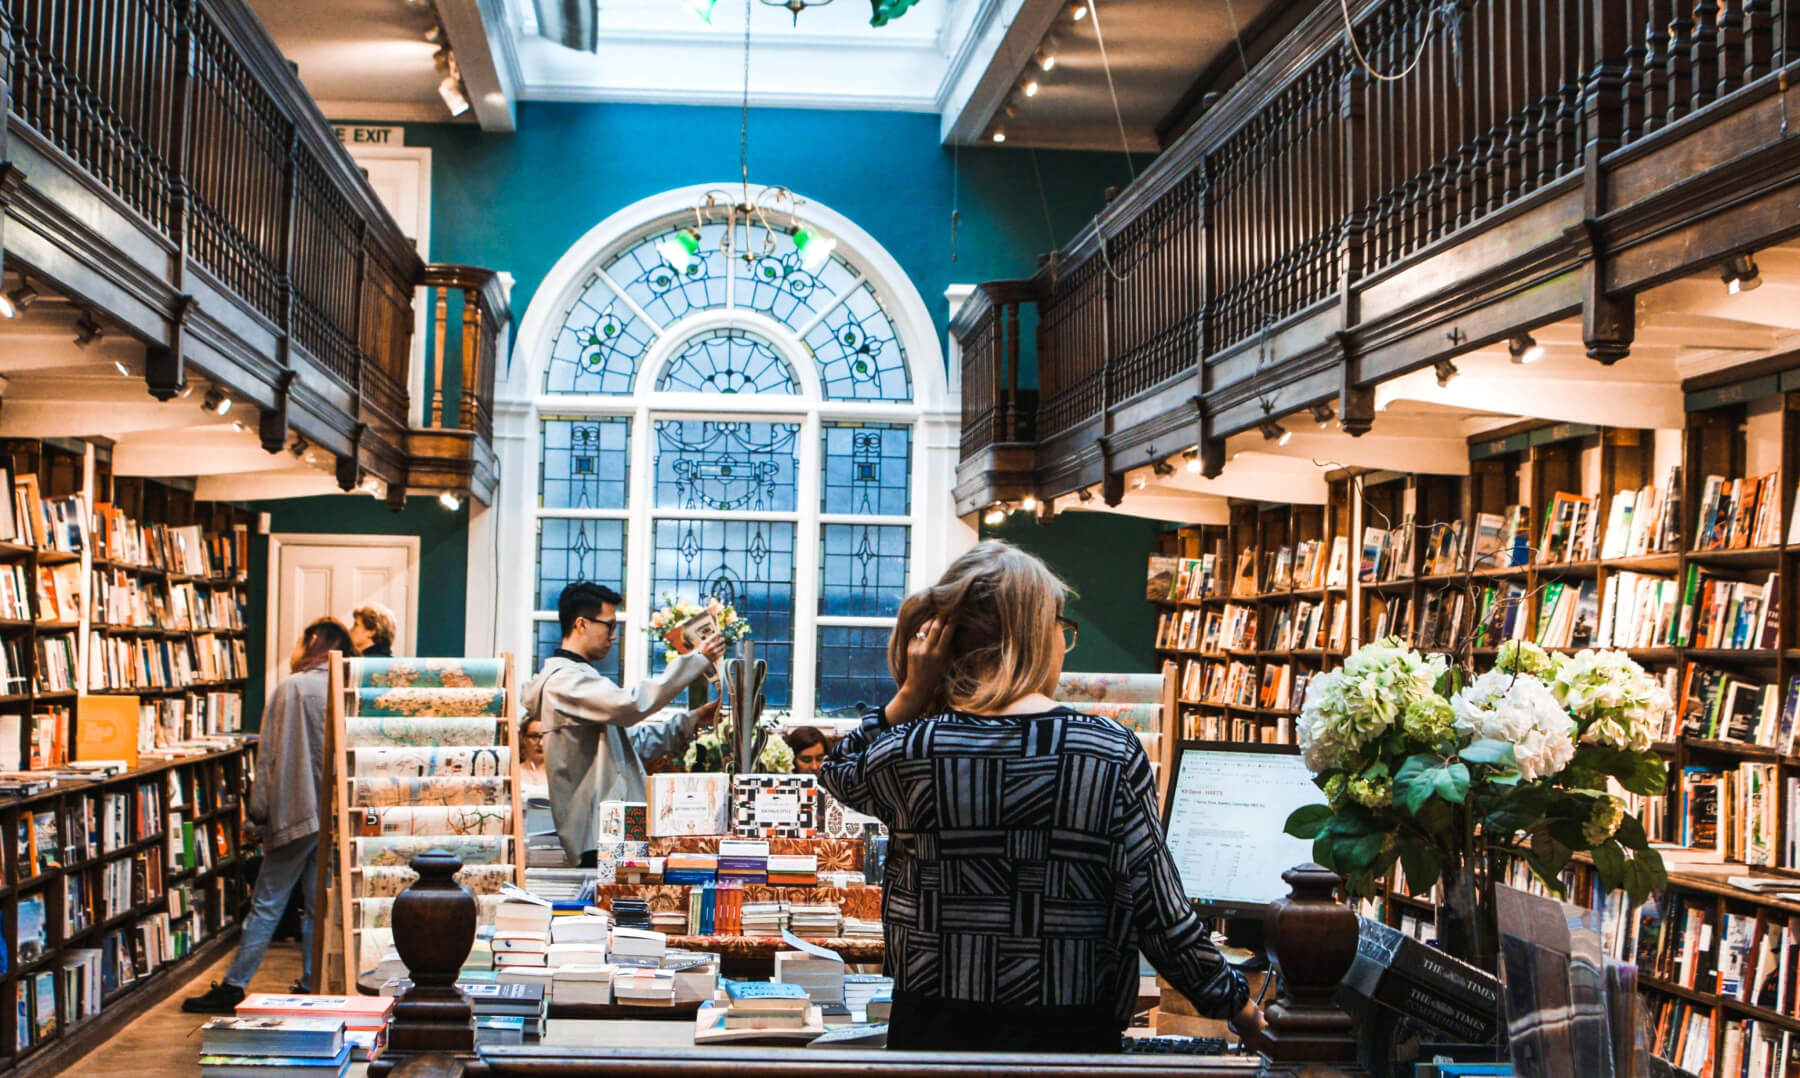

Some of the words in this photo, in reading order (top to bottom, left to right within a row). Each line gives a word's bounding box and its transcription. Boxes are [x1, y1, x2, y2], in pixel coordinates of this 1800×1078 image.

[354, 128, 391, 143] EXIT
[1424, 959, 1445, 975] THE
[1467, 981, 1497, 1001] TIMES
[1411, 989, 1431, 1006] THE
[1455, 1010, 1486, 1030] TIMES
